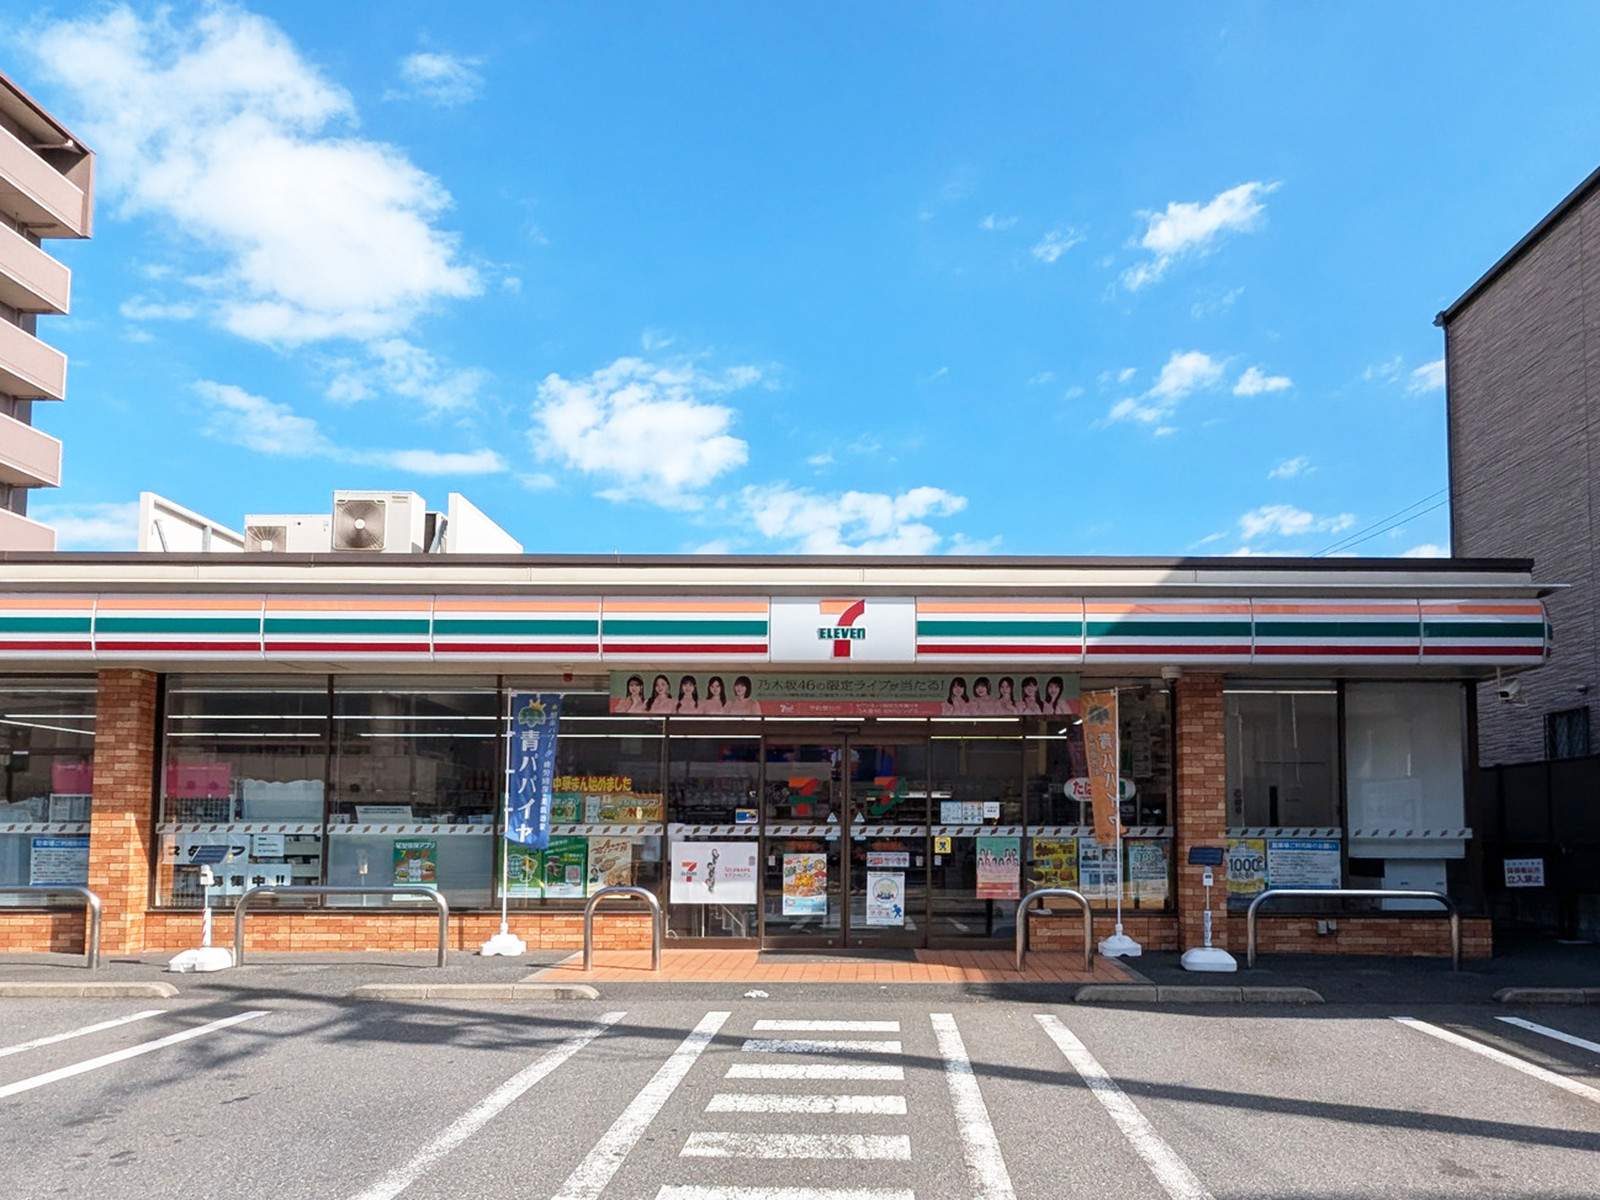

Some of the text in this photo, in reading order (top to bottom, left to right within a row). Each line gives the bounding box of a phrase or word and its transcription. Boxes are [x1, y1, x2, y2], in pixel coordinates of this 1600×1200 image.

[515, 730, 541, 843] 青パパイヤ
[552, 776, 632, 792] 中華まん始めました
[1507, 874, 1542, 884] 立入禁止
